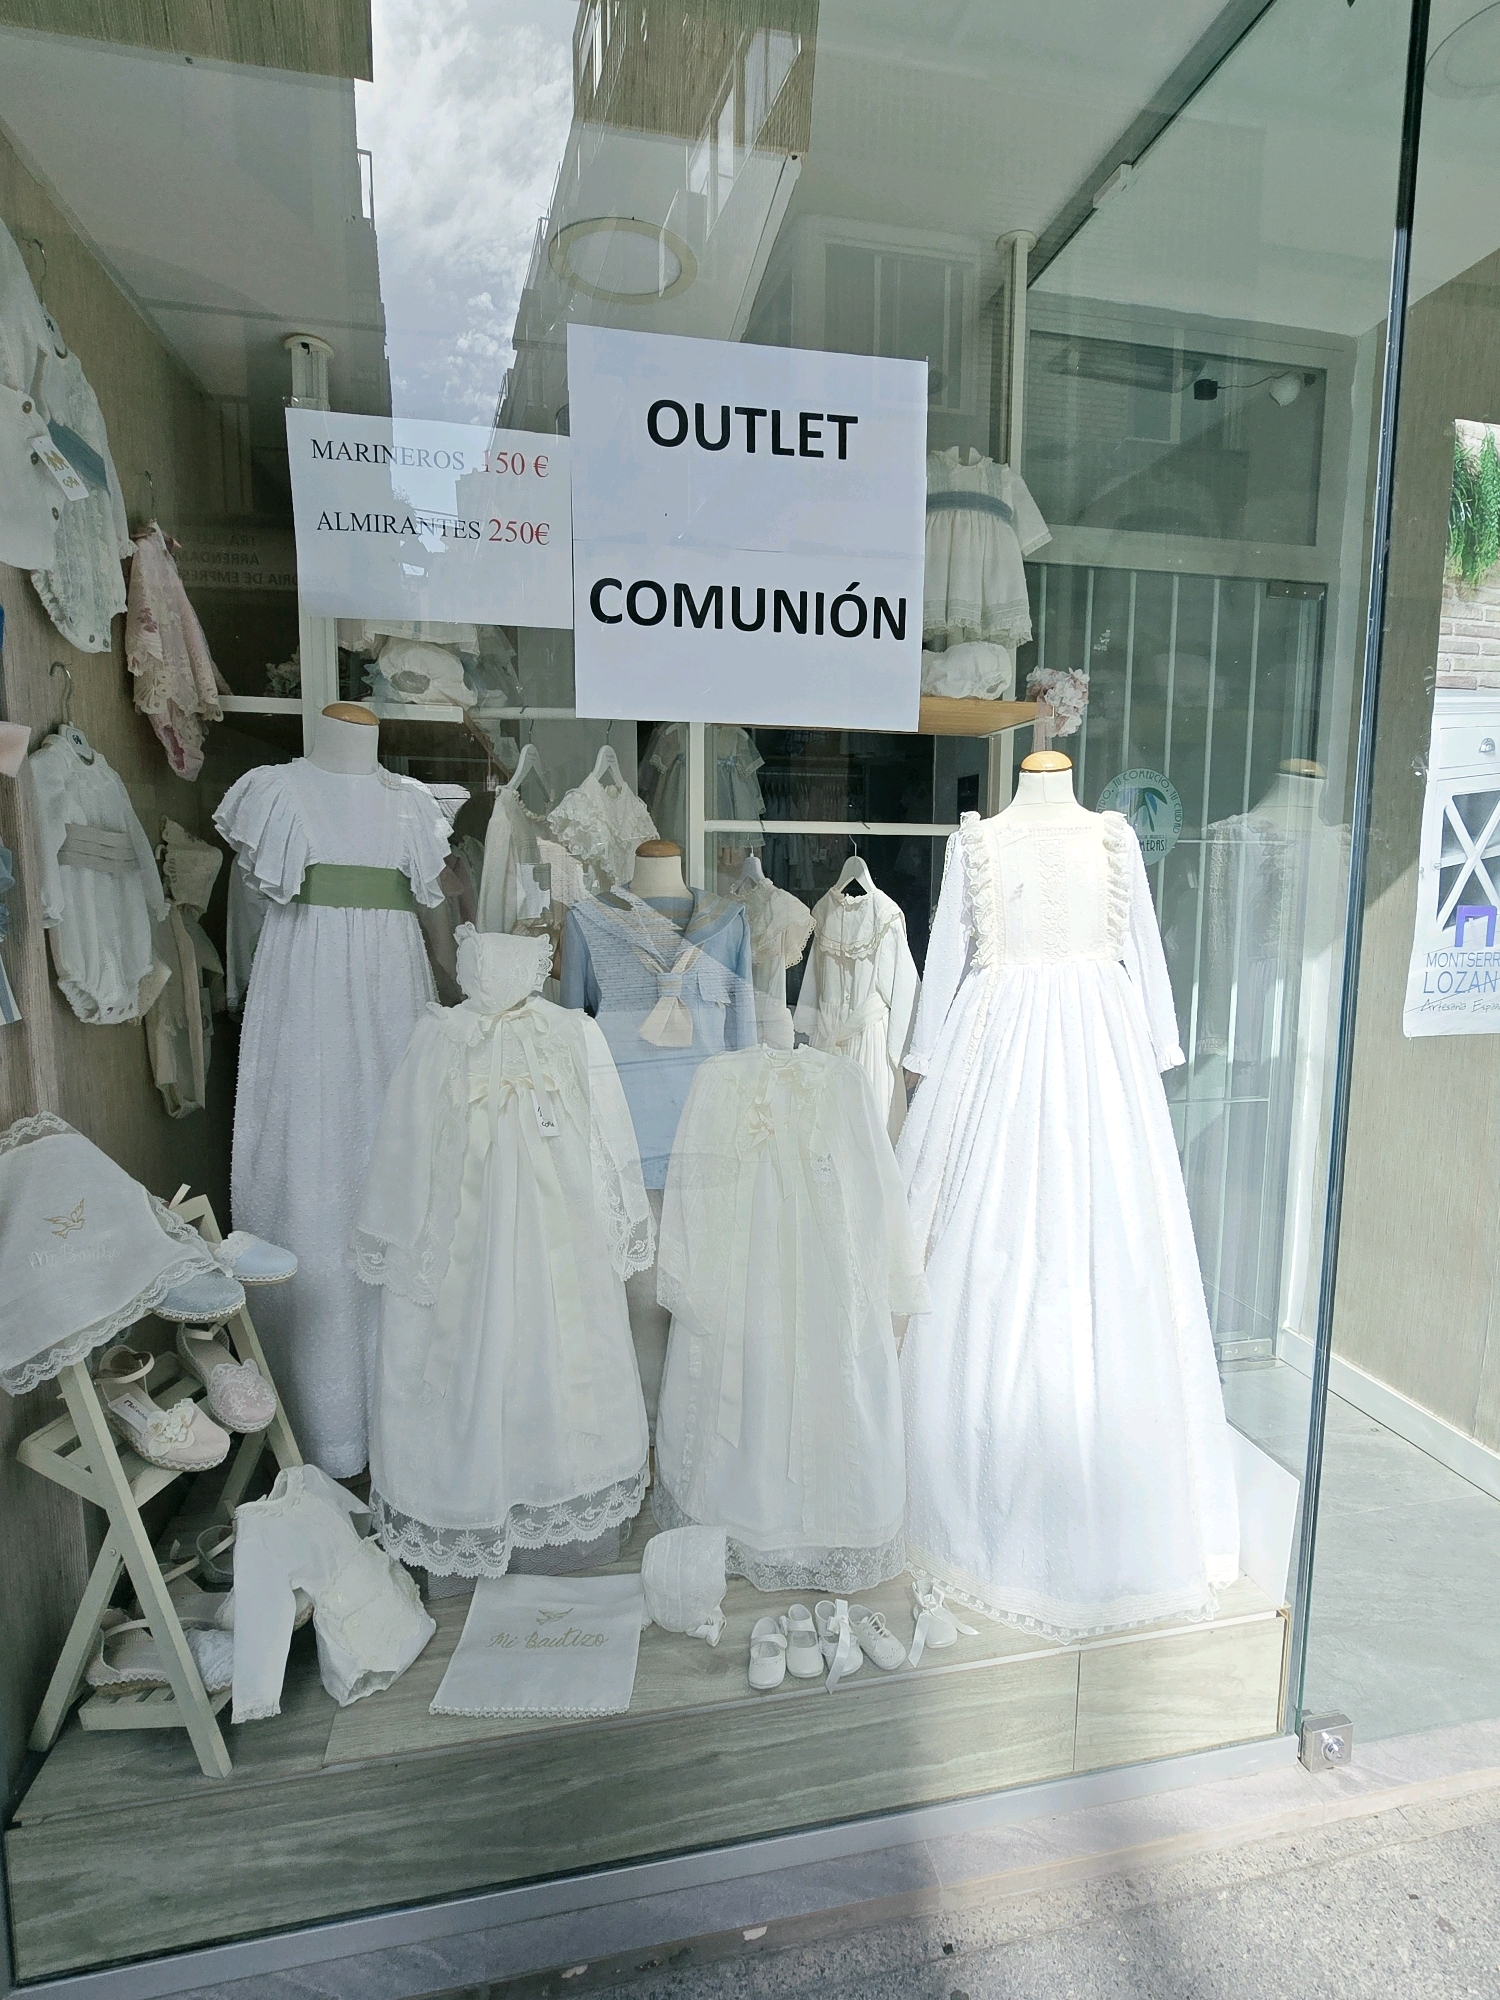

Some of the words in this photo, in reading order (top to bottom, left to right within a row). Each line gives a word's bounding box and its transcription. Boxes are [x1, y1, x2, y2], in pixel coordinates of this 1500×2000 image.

[647, 399, 859, 460] OUTLET
[310, 438, 465, 470] MARINEROS
[482, 450, 526, 476] 150
[316, 511, 481, 540] ALMIRANTES
[589, 577, 907, 641] COMUNIÓN
[485, 1631, 521, 1649] Mi
[523, 1627, 610, 1649] Bautizo
